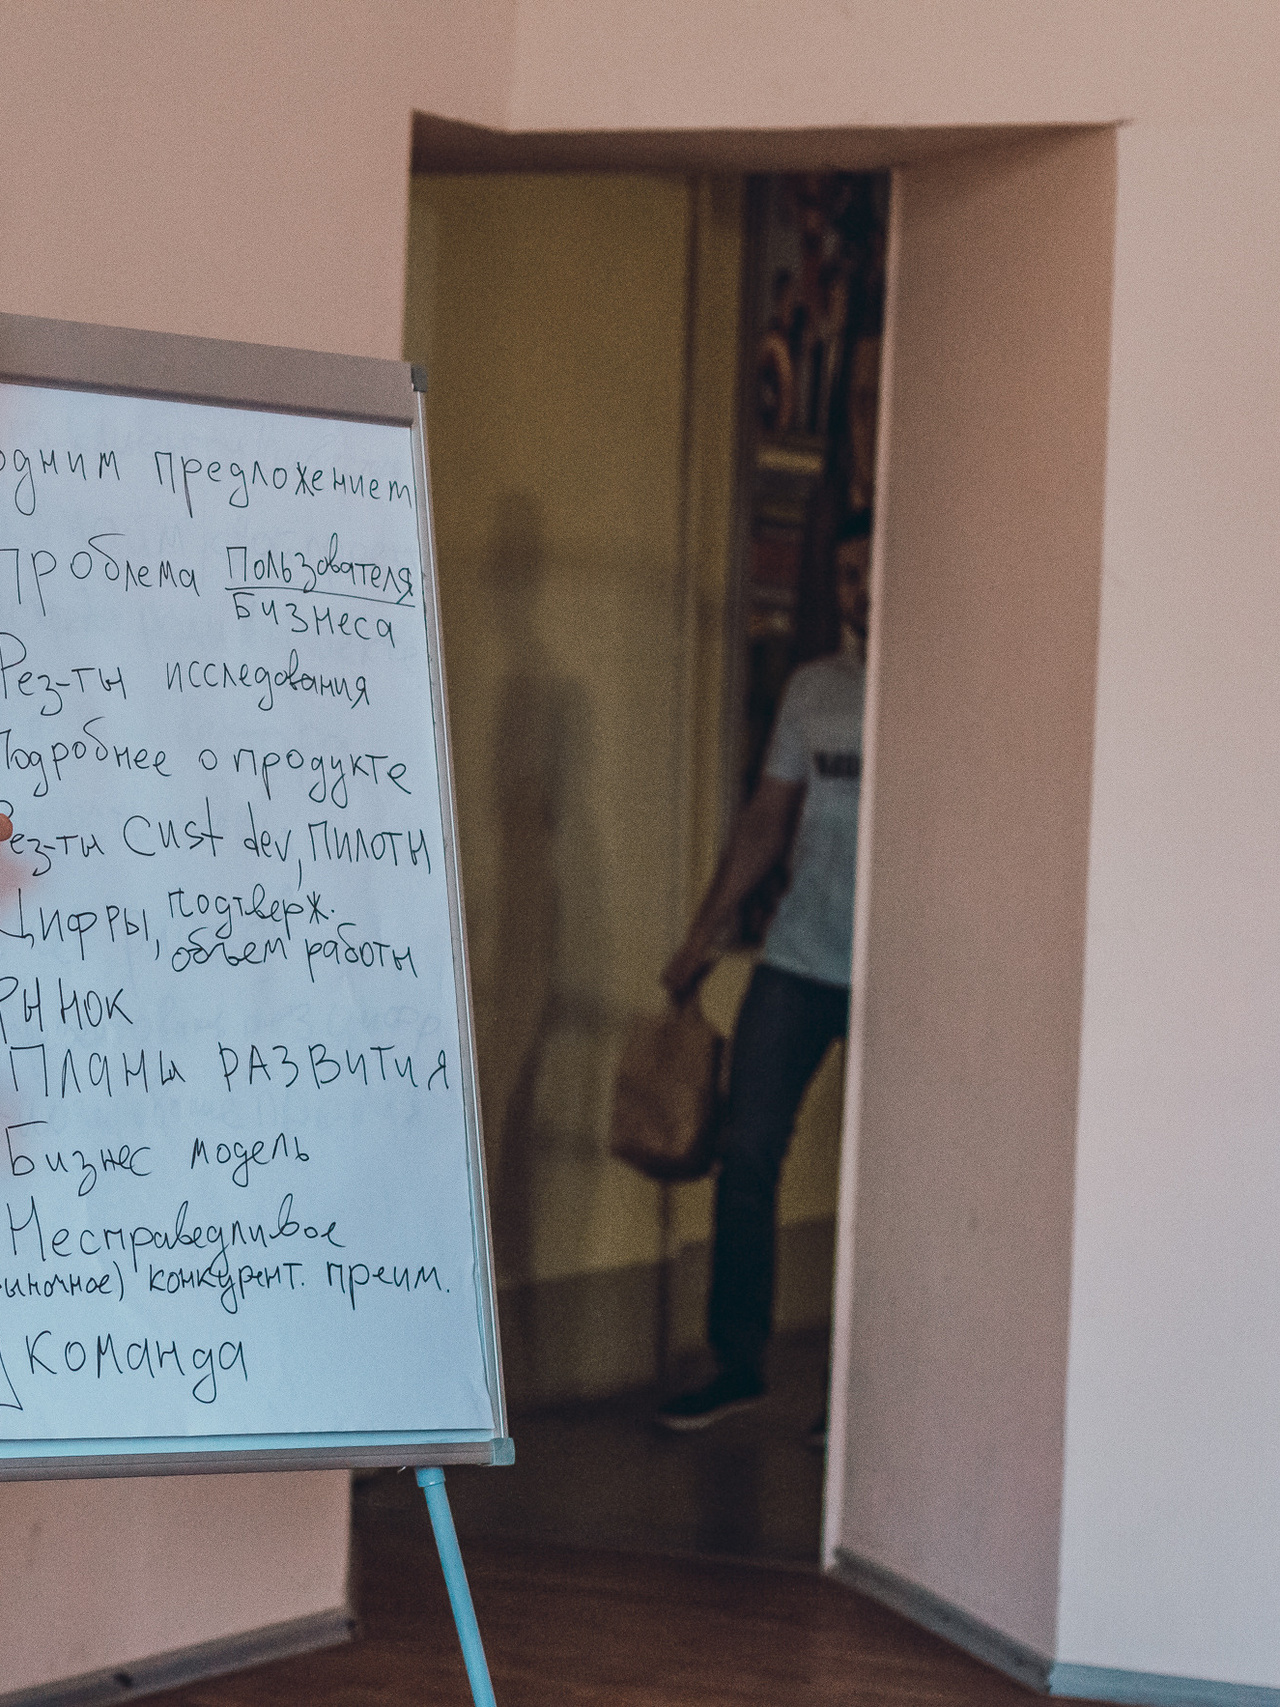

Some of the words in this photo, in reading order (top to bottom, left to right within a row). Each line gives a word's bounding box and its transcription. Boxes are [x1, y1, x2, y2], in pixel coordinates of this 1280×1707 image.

[154, 450, 413, 519] предложением
[225, 532, 414, 605] Пользователя
[165, 648, 370, 711] исследования
[198, 748, 218, 771] о
[233, 748, 412, 809] продукте
[304, 922, 419, 984] работы
[5, 1120, 153, 1197] Бизнес
[191, 1132, 310, 1188] модель
[6, 1193, 347, 1273] Несправедливое
[326, 1260, 451, 1311] преим.
